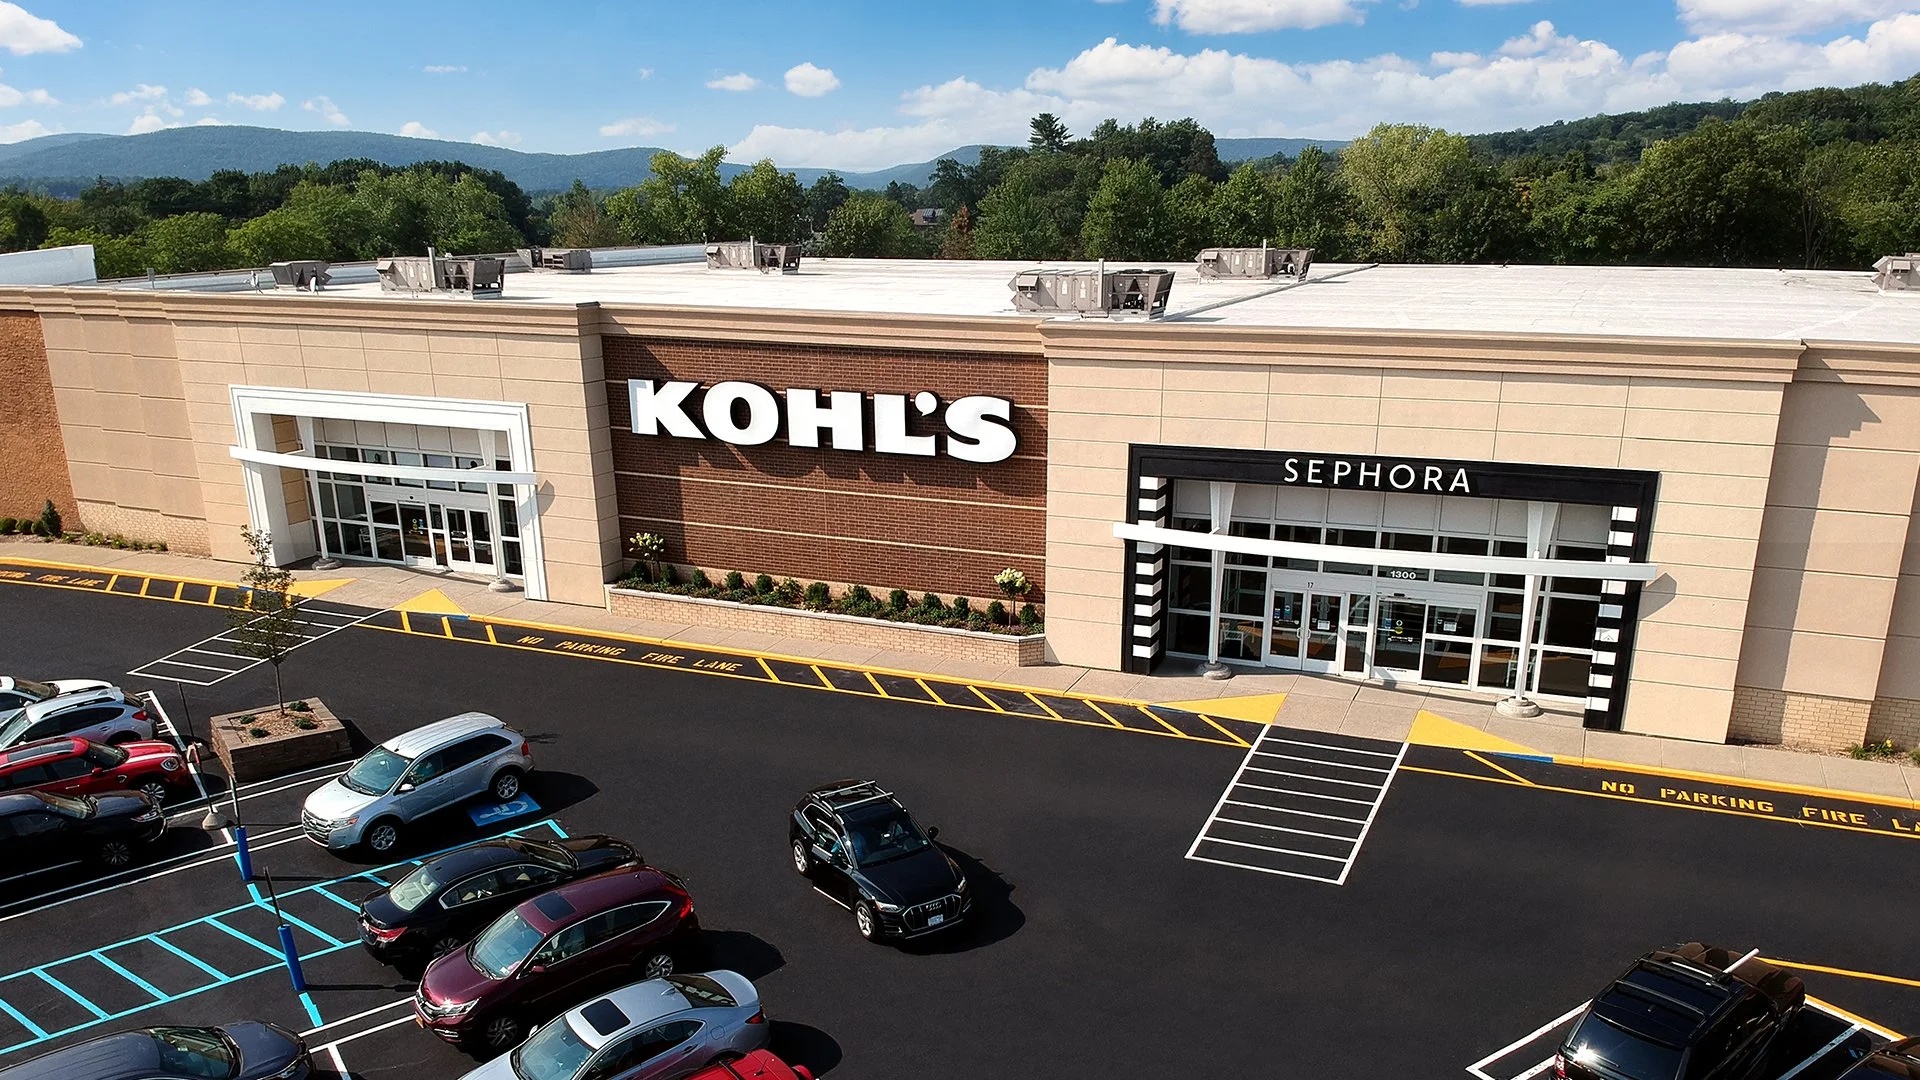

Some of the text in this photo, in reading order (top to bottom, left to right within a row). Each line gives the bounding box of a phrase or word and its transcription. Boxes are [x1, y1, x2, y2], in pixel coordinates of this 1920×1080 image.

[627, 378, 1018, 464] KOHL'S
[1283, 457, 1470, 493] SEPHORA
[1390, 570, 1417, 580] 1300
[516, 635, 743, 672] NO PARKING FIRE LANE
[1601, 780, 1635, 795] NO
[1660, 788, 1776, 813] PARKING
[1802, 806, 1869, 826] FIRE
